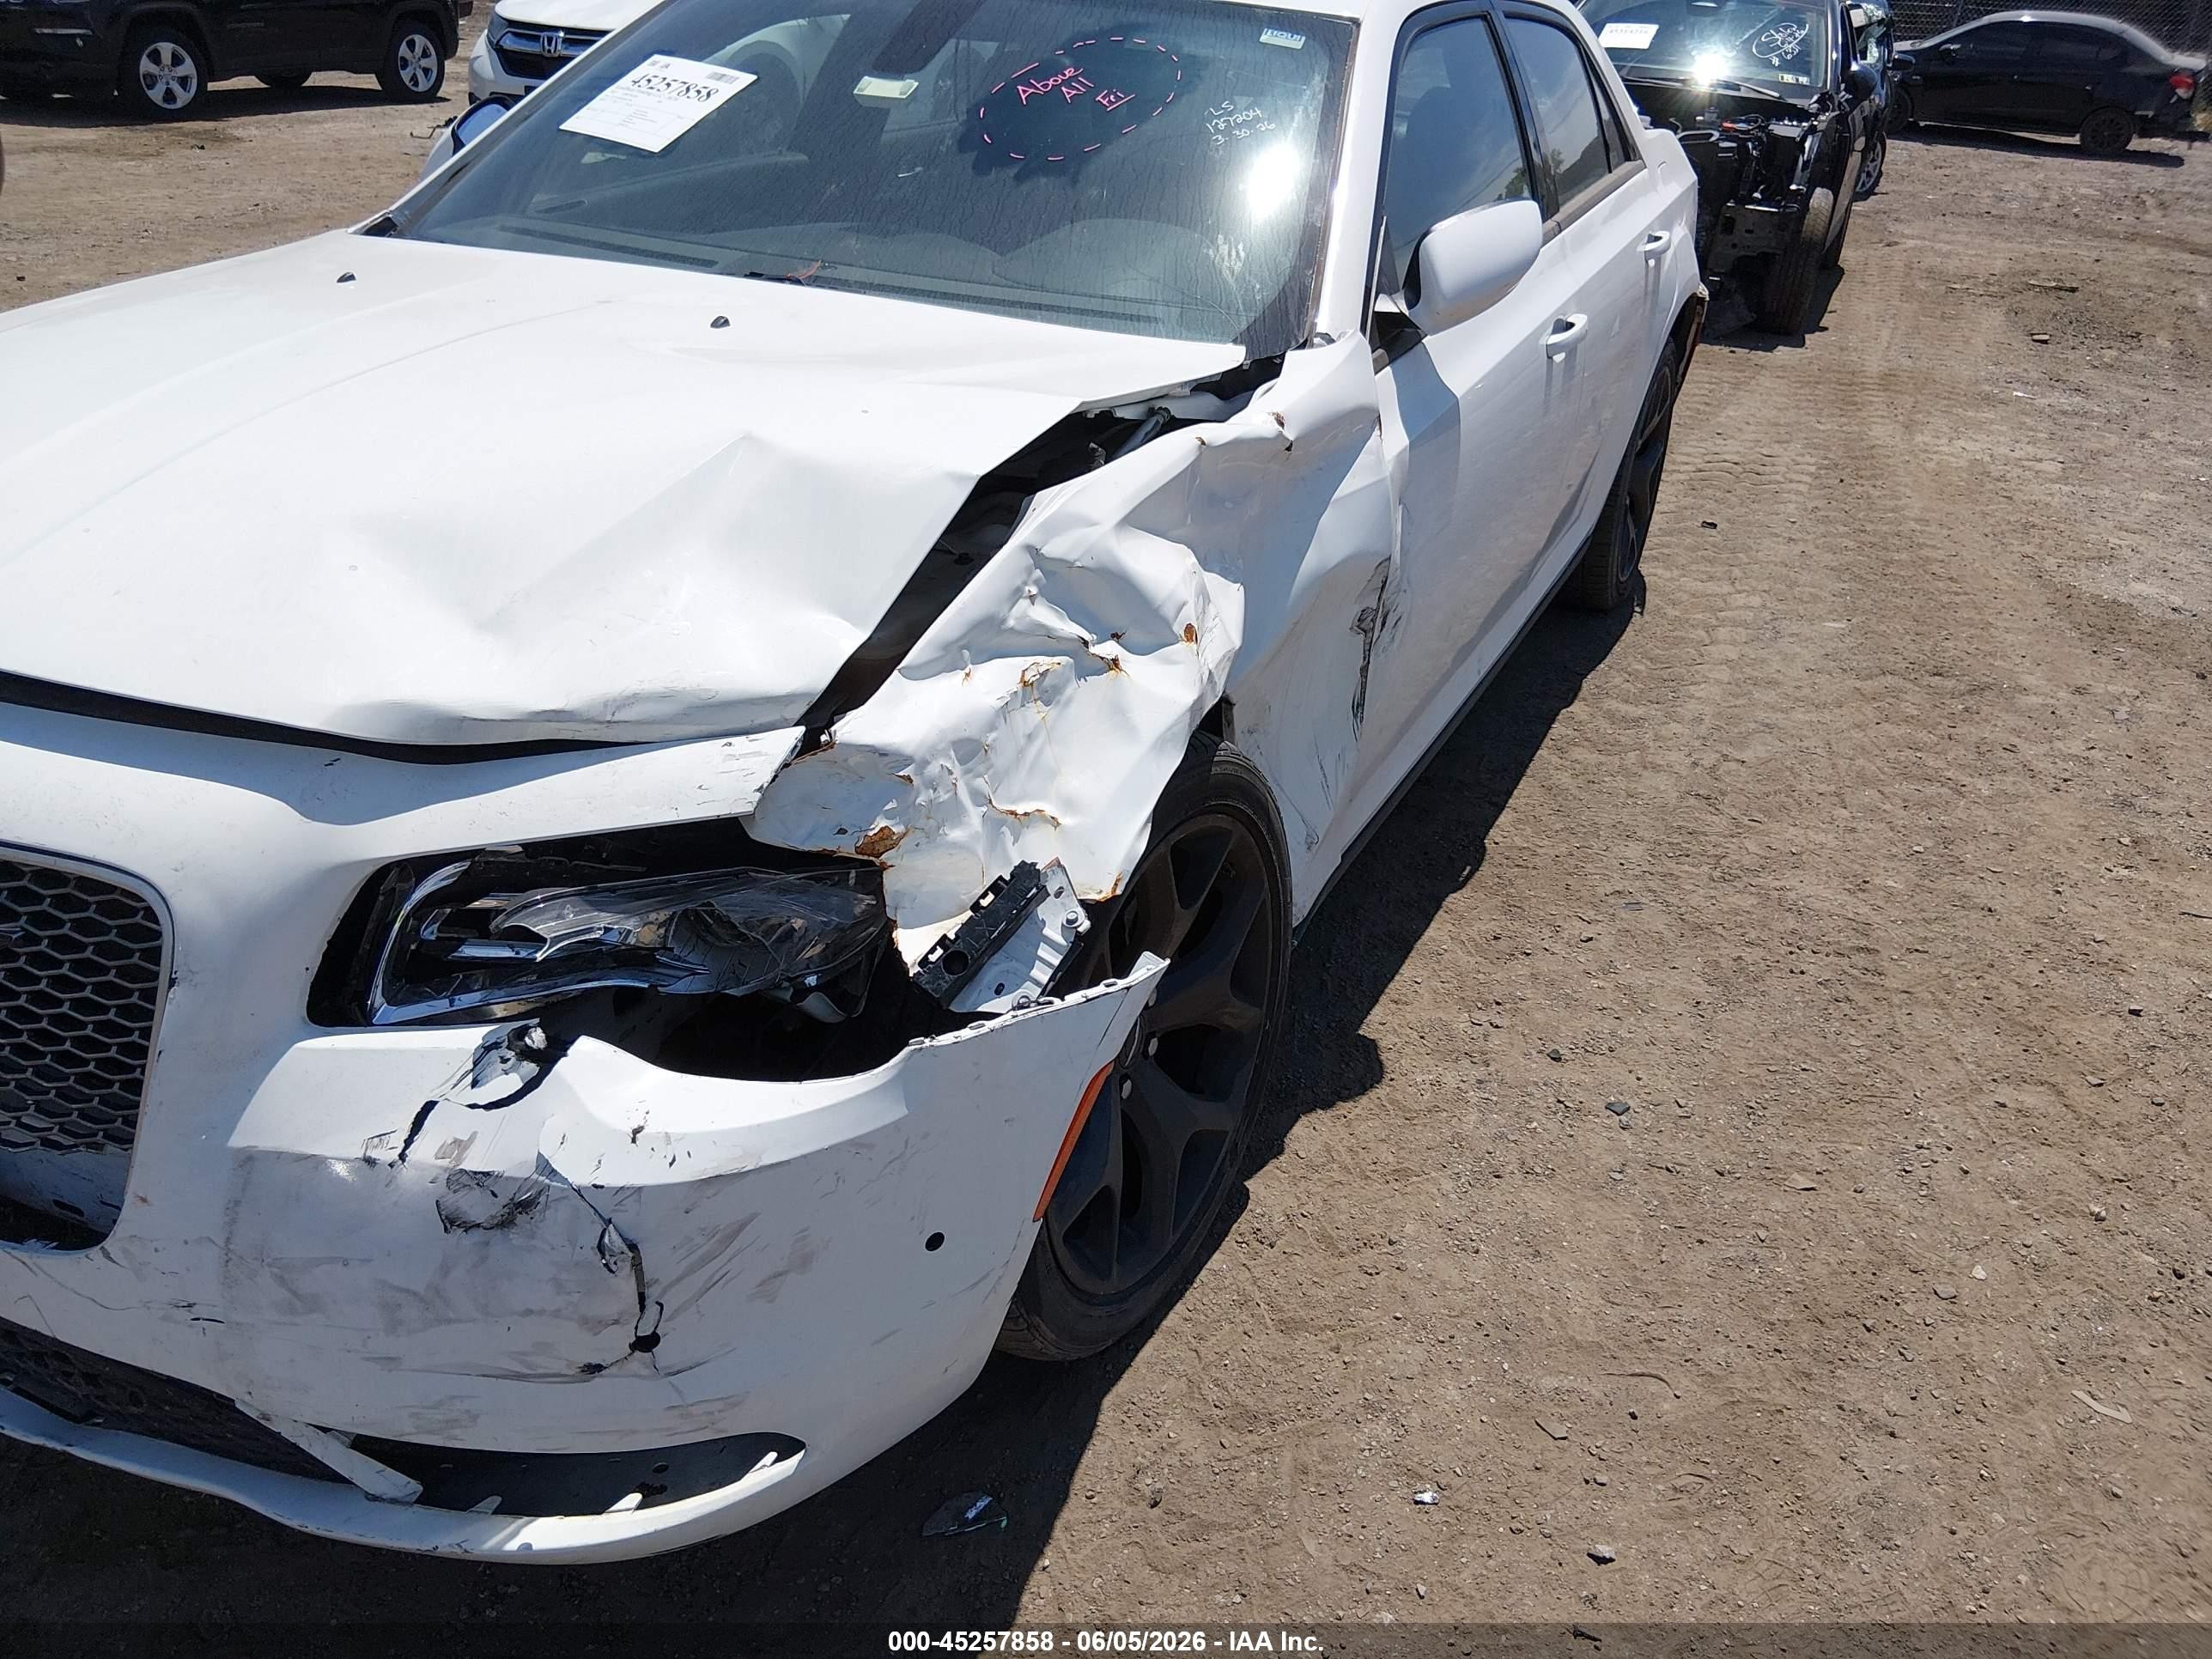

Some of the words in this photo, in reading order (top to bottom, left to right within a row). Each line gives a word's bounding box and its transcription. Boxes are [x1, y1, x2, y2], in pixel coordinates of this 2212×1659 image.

[631, 73, 720, 102] 45257858
[1017, 68, 1084, 105] Above
[1061, 77, 1095, 103] All
[1096, 88, 1125, 106] Fri
[1206, 106, 1262, 133] 127204
[1210, 100, 1234, 116] LS
